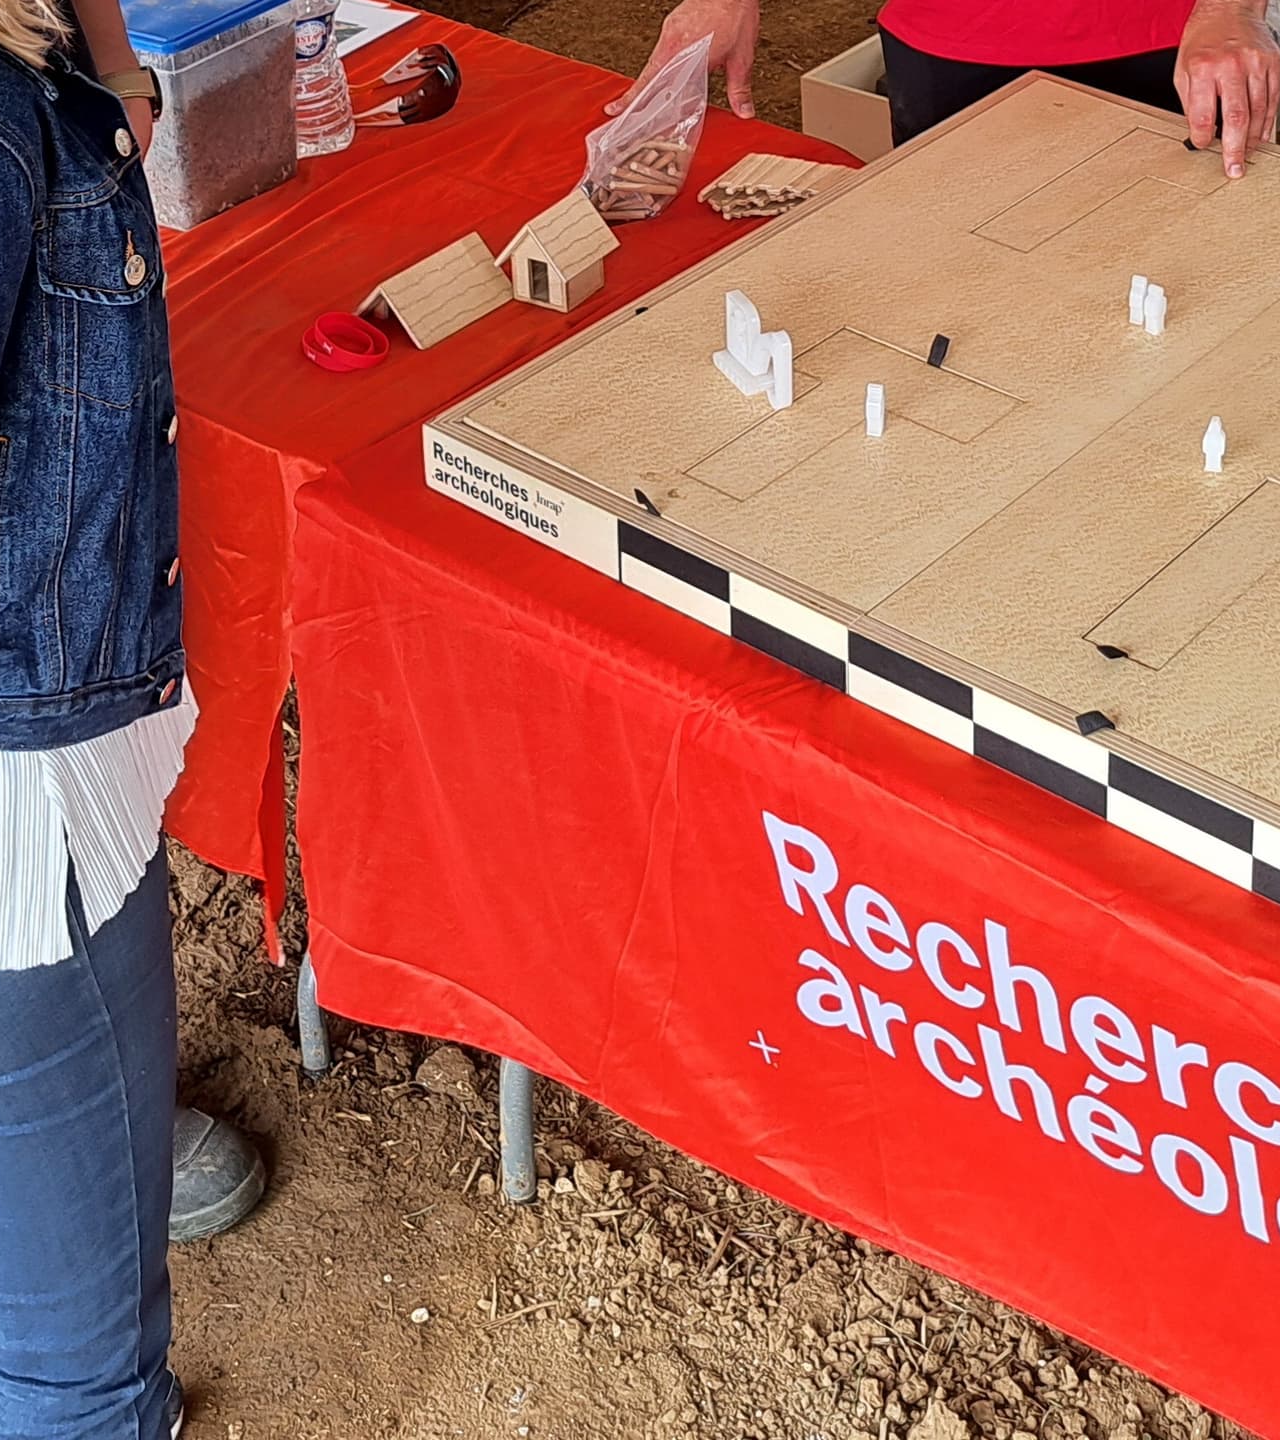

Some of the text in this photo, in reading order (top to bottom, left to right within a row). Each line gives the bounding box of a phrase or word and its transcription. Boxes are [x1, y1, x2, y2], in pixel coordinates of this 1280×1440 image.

[433, 440, 529, 502] Recherches
[435, 467, 559, 539] archéologiques
[536, 490, 563, 517] Inrap
